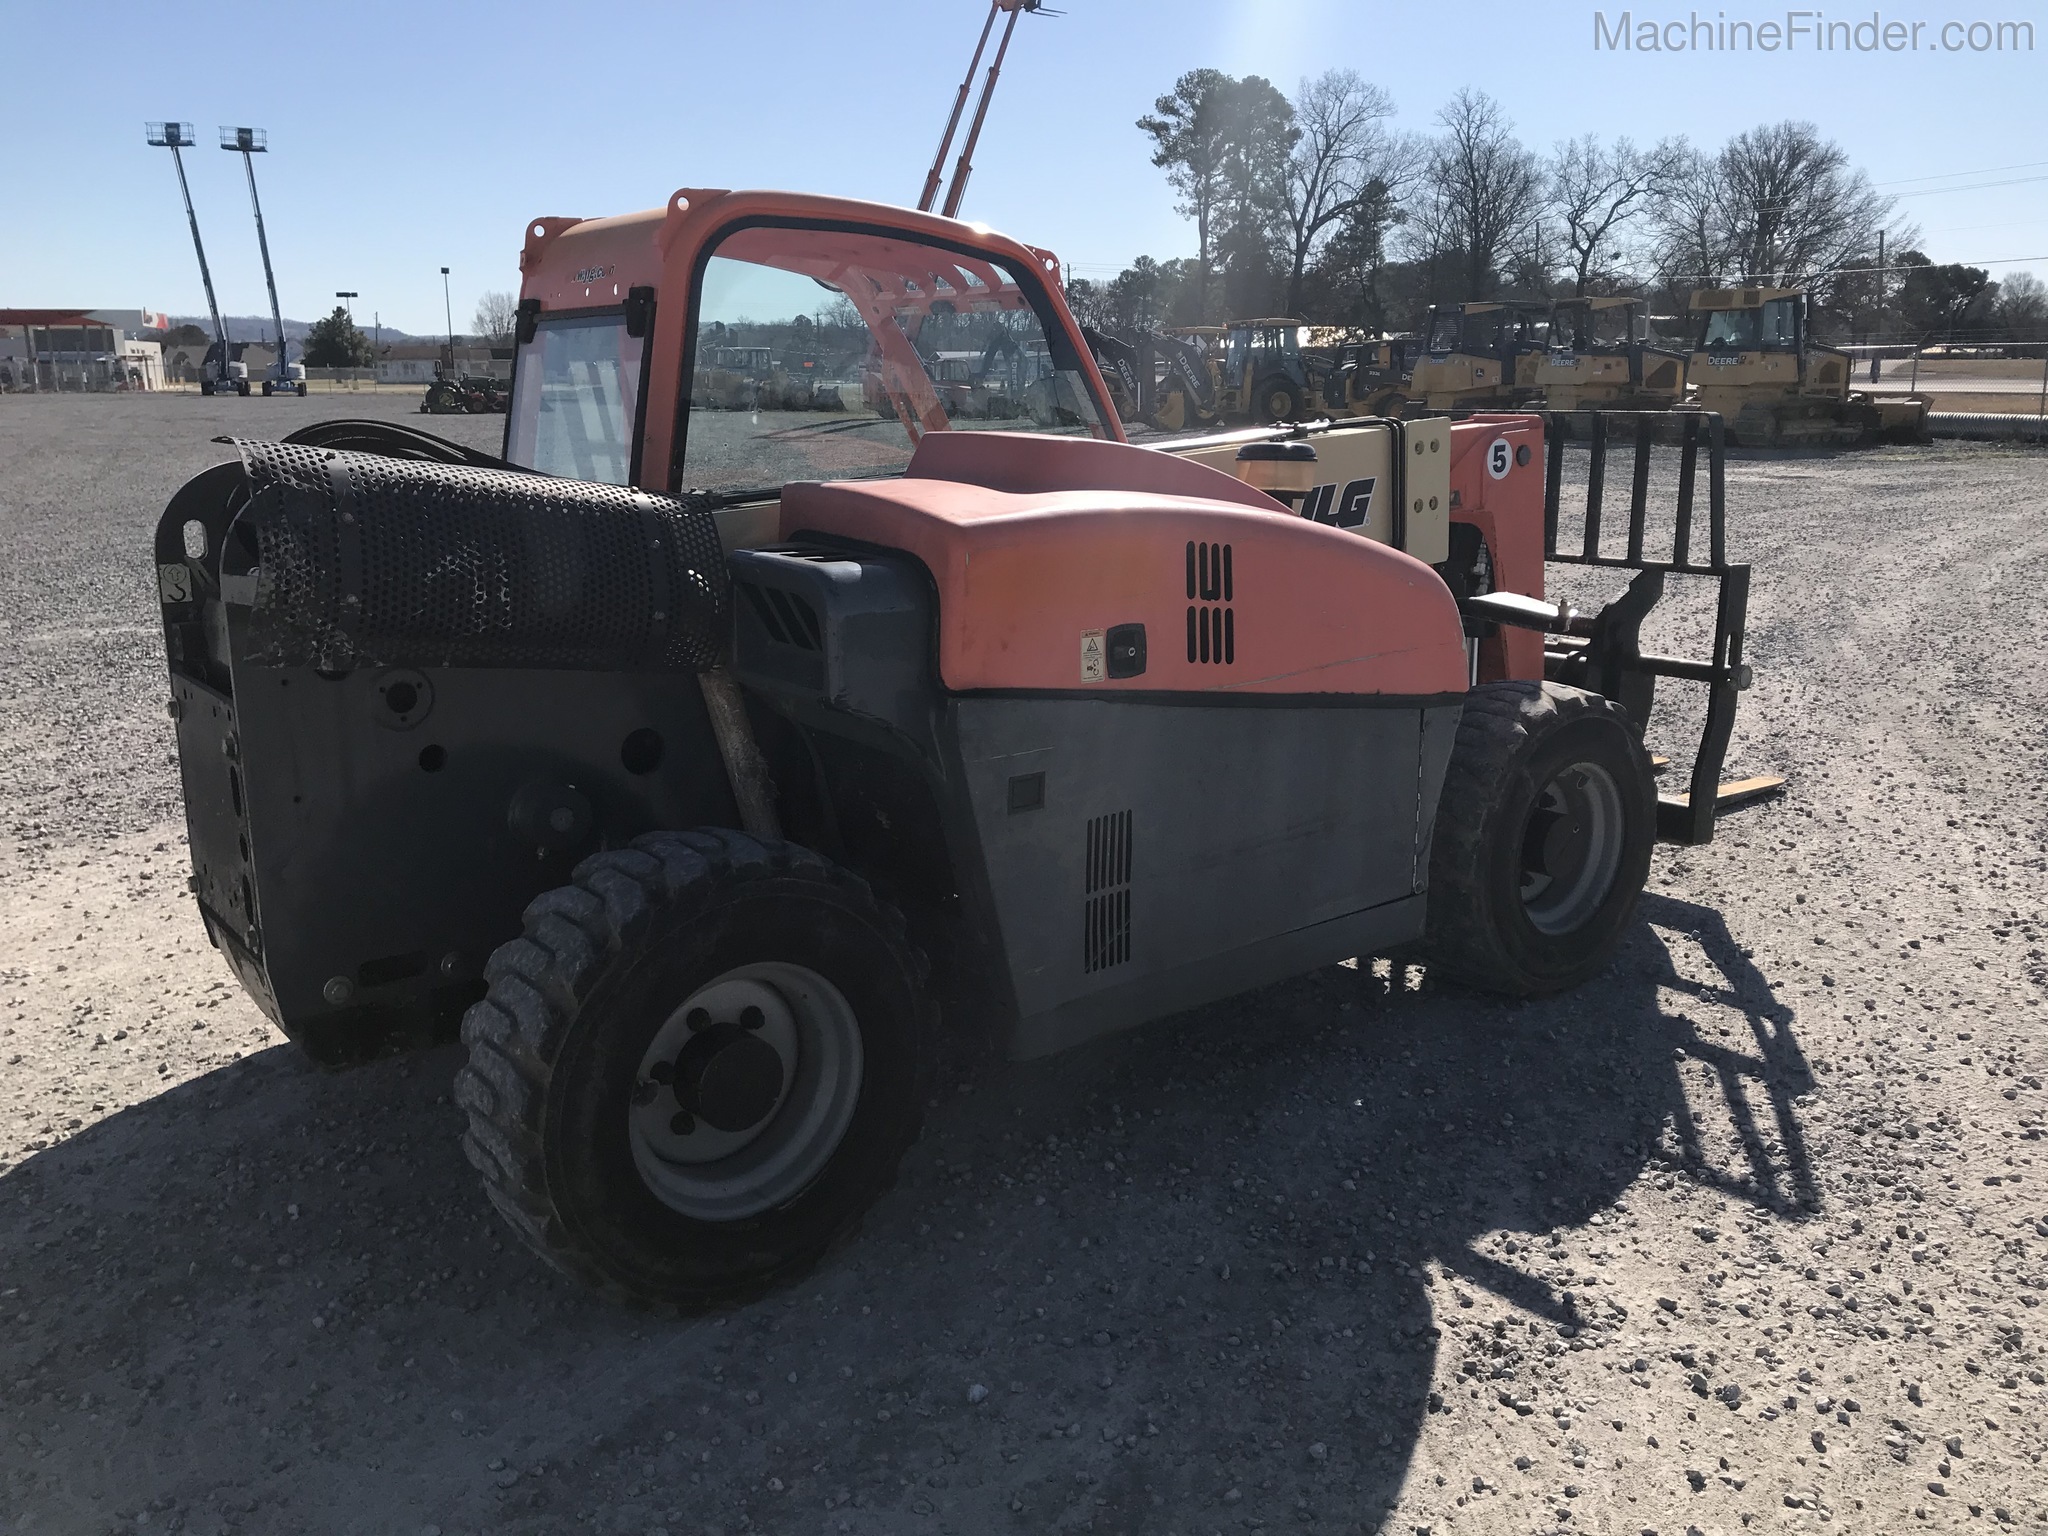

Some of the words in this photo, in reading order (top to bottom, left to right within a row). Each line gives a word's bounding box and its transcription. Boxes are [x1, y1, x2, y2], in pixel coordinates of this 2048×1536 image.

[1117, 358, 1136, 390] DEERE
[1179, 356, 1201, 389] DEERE
[1551, 358, 1575, 367] DEERE
[1707, 356, 1739, 366] DEERE
[1492, 444, 1507, 474] 5
